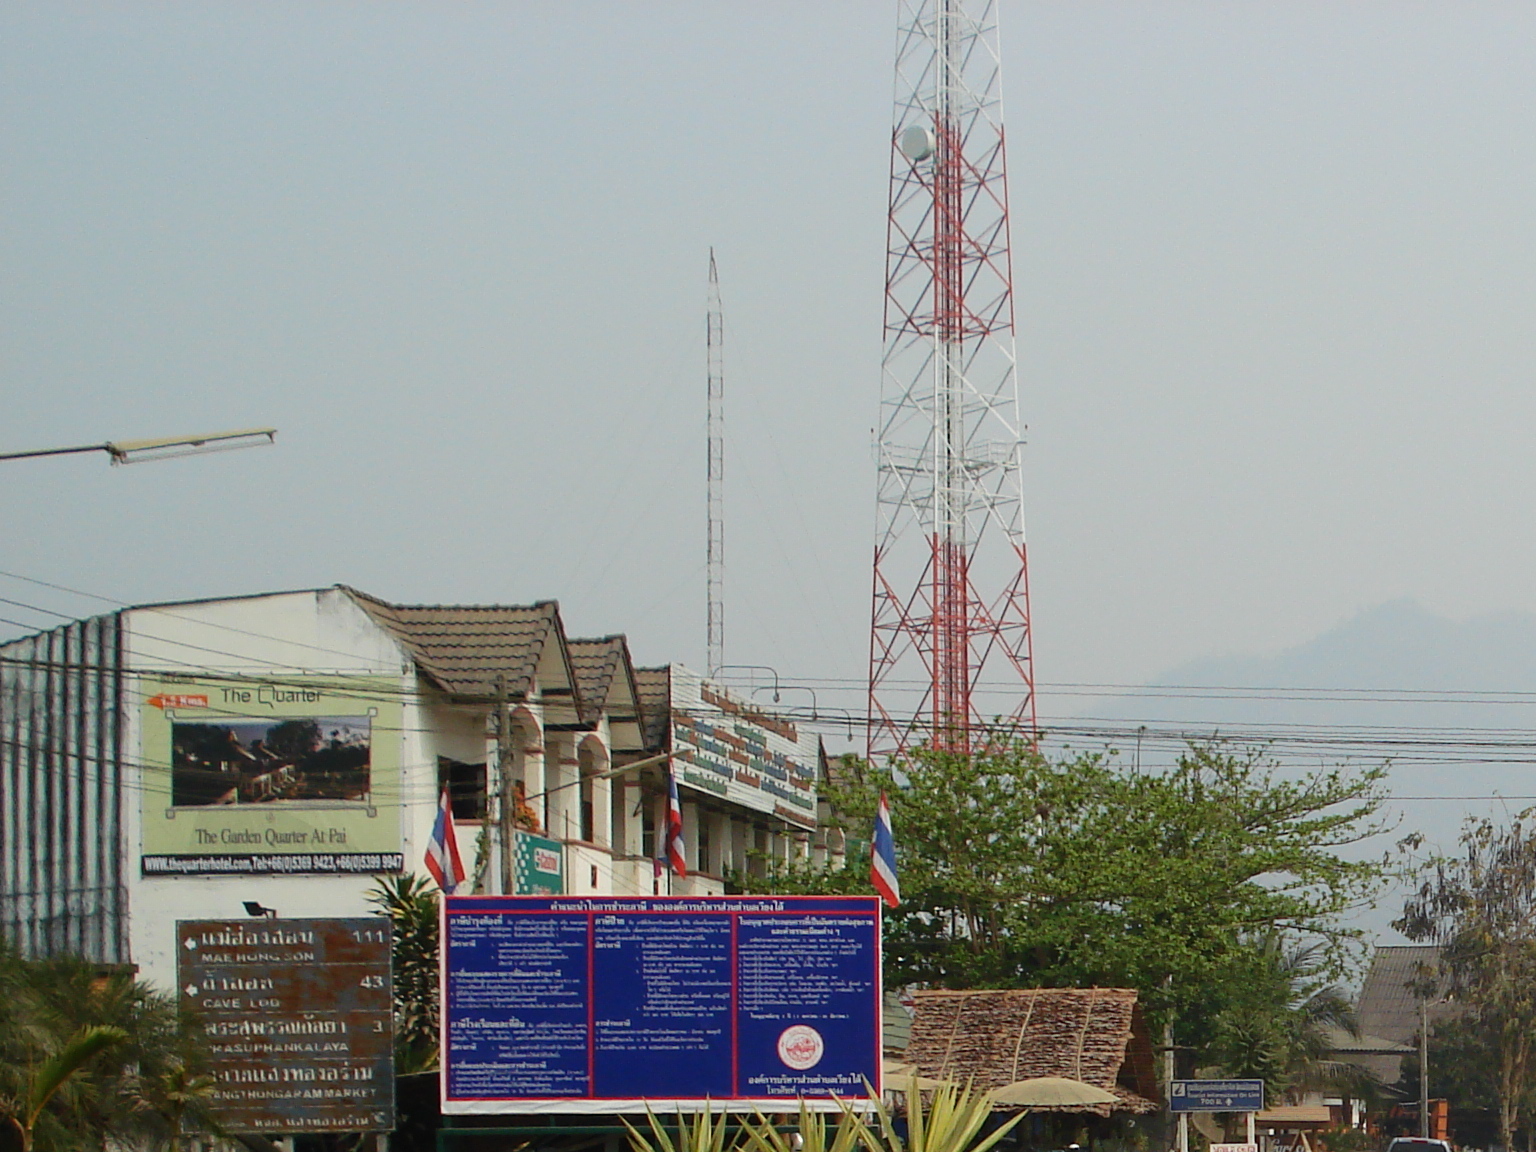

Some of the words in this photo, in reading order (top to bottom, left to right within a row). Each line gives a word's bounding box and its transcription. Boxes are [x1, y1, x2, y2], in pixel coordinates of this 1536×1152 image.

[221, 687, 251, 704] The
[258, 685, 322, 710] Quarter
[195, 828, 218, 844] The
[220, 828, 262, 844] Garden
[264, 828, 308, 845] Quarter
[311, 828, 326, 843] At
[328, 826, 347, 843] Pai
[352, 929, 385, 944] 111
[201, 953, 233, 964] MAE
[236, 952, 281, 962] HONG
[284, 951, 315, 962] SON
[360, 974, 385, 989] 43
[203, 998, 241, 1009] CAVE
[372, 1020, 385, 1033] 3
